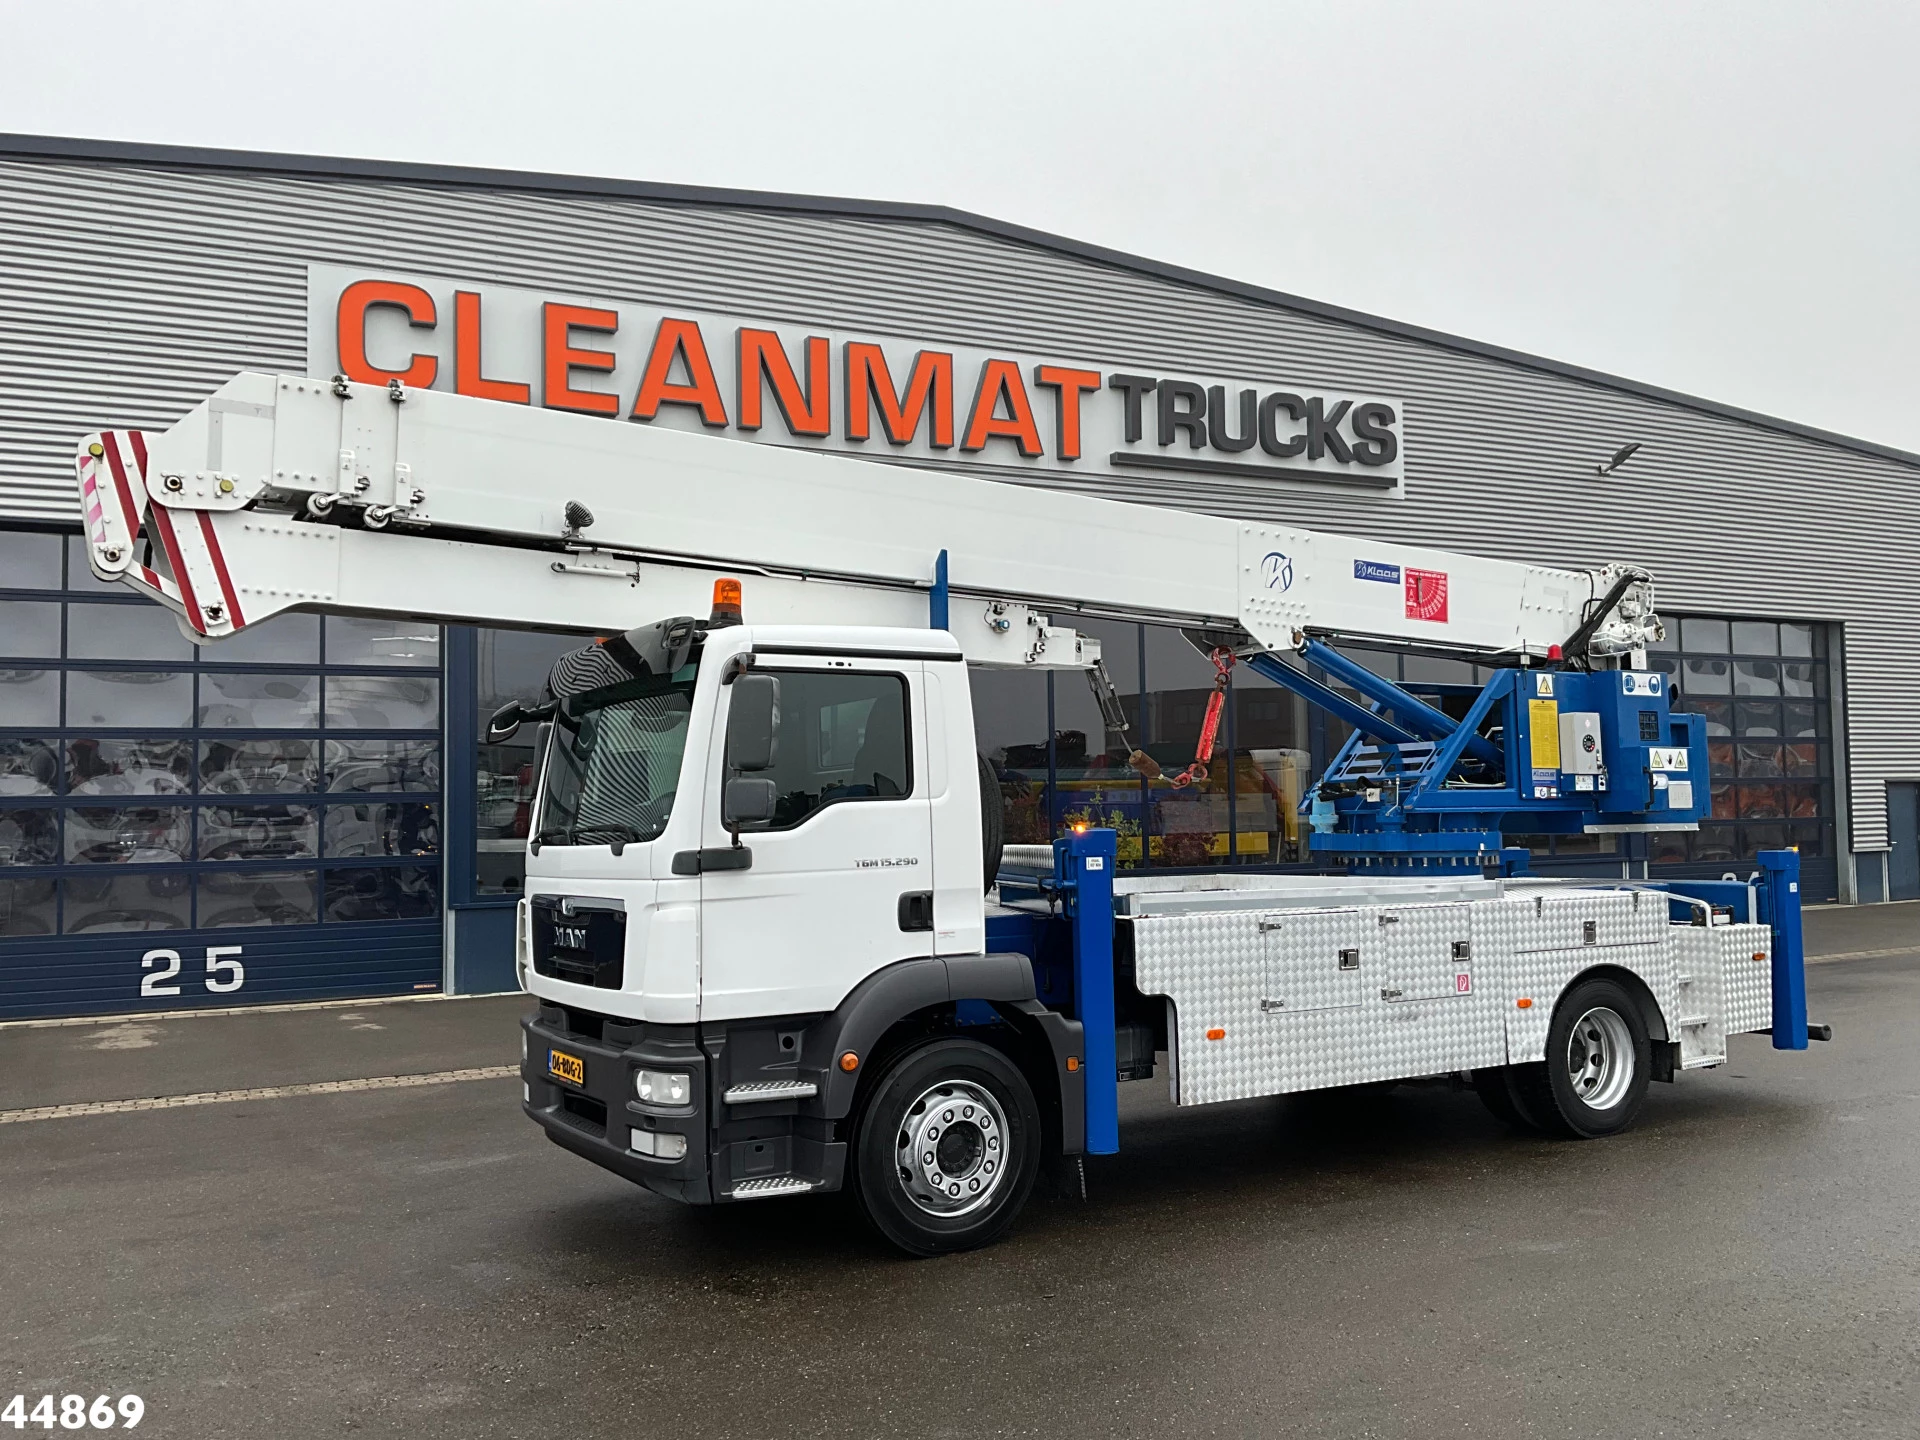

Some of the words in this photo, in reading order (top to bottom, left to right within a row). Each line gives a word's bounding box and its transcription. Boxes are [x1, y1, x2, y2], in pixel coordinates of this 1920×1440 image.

[337, 279, 1101, 461] CLEANMAT
[1109, 373, 1398, 466] TRUCKS
[1366, 565, 1400, 579] Klaas
[880, 857, 918, 867] 15.290
[553, 926, 587, 949] MAN
